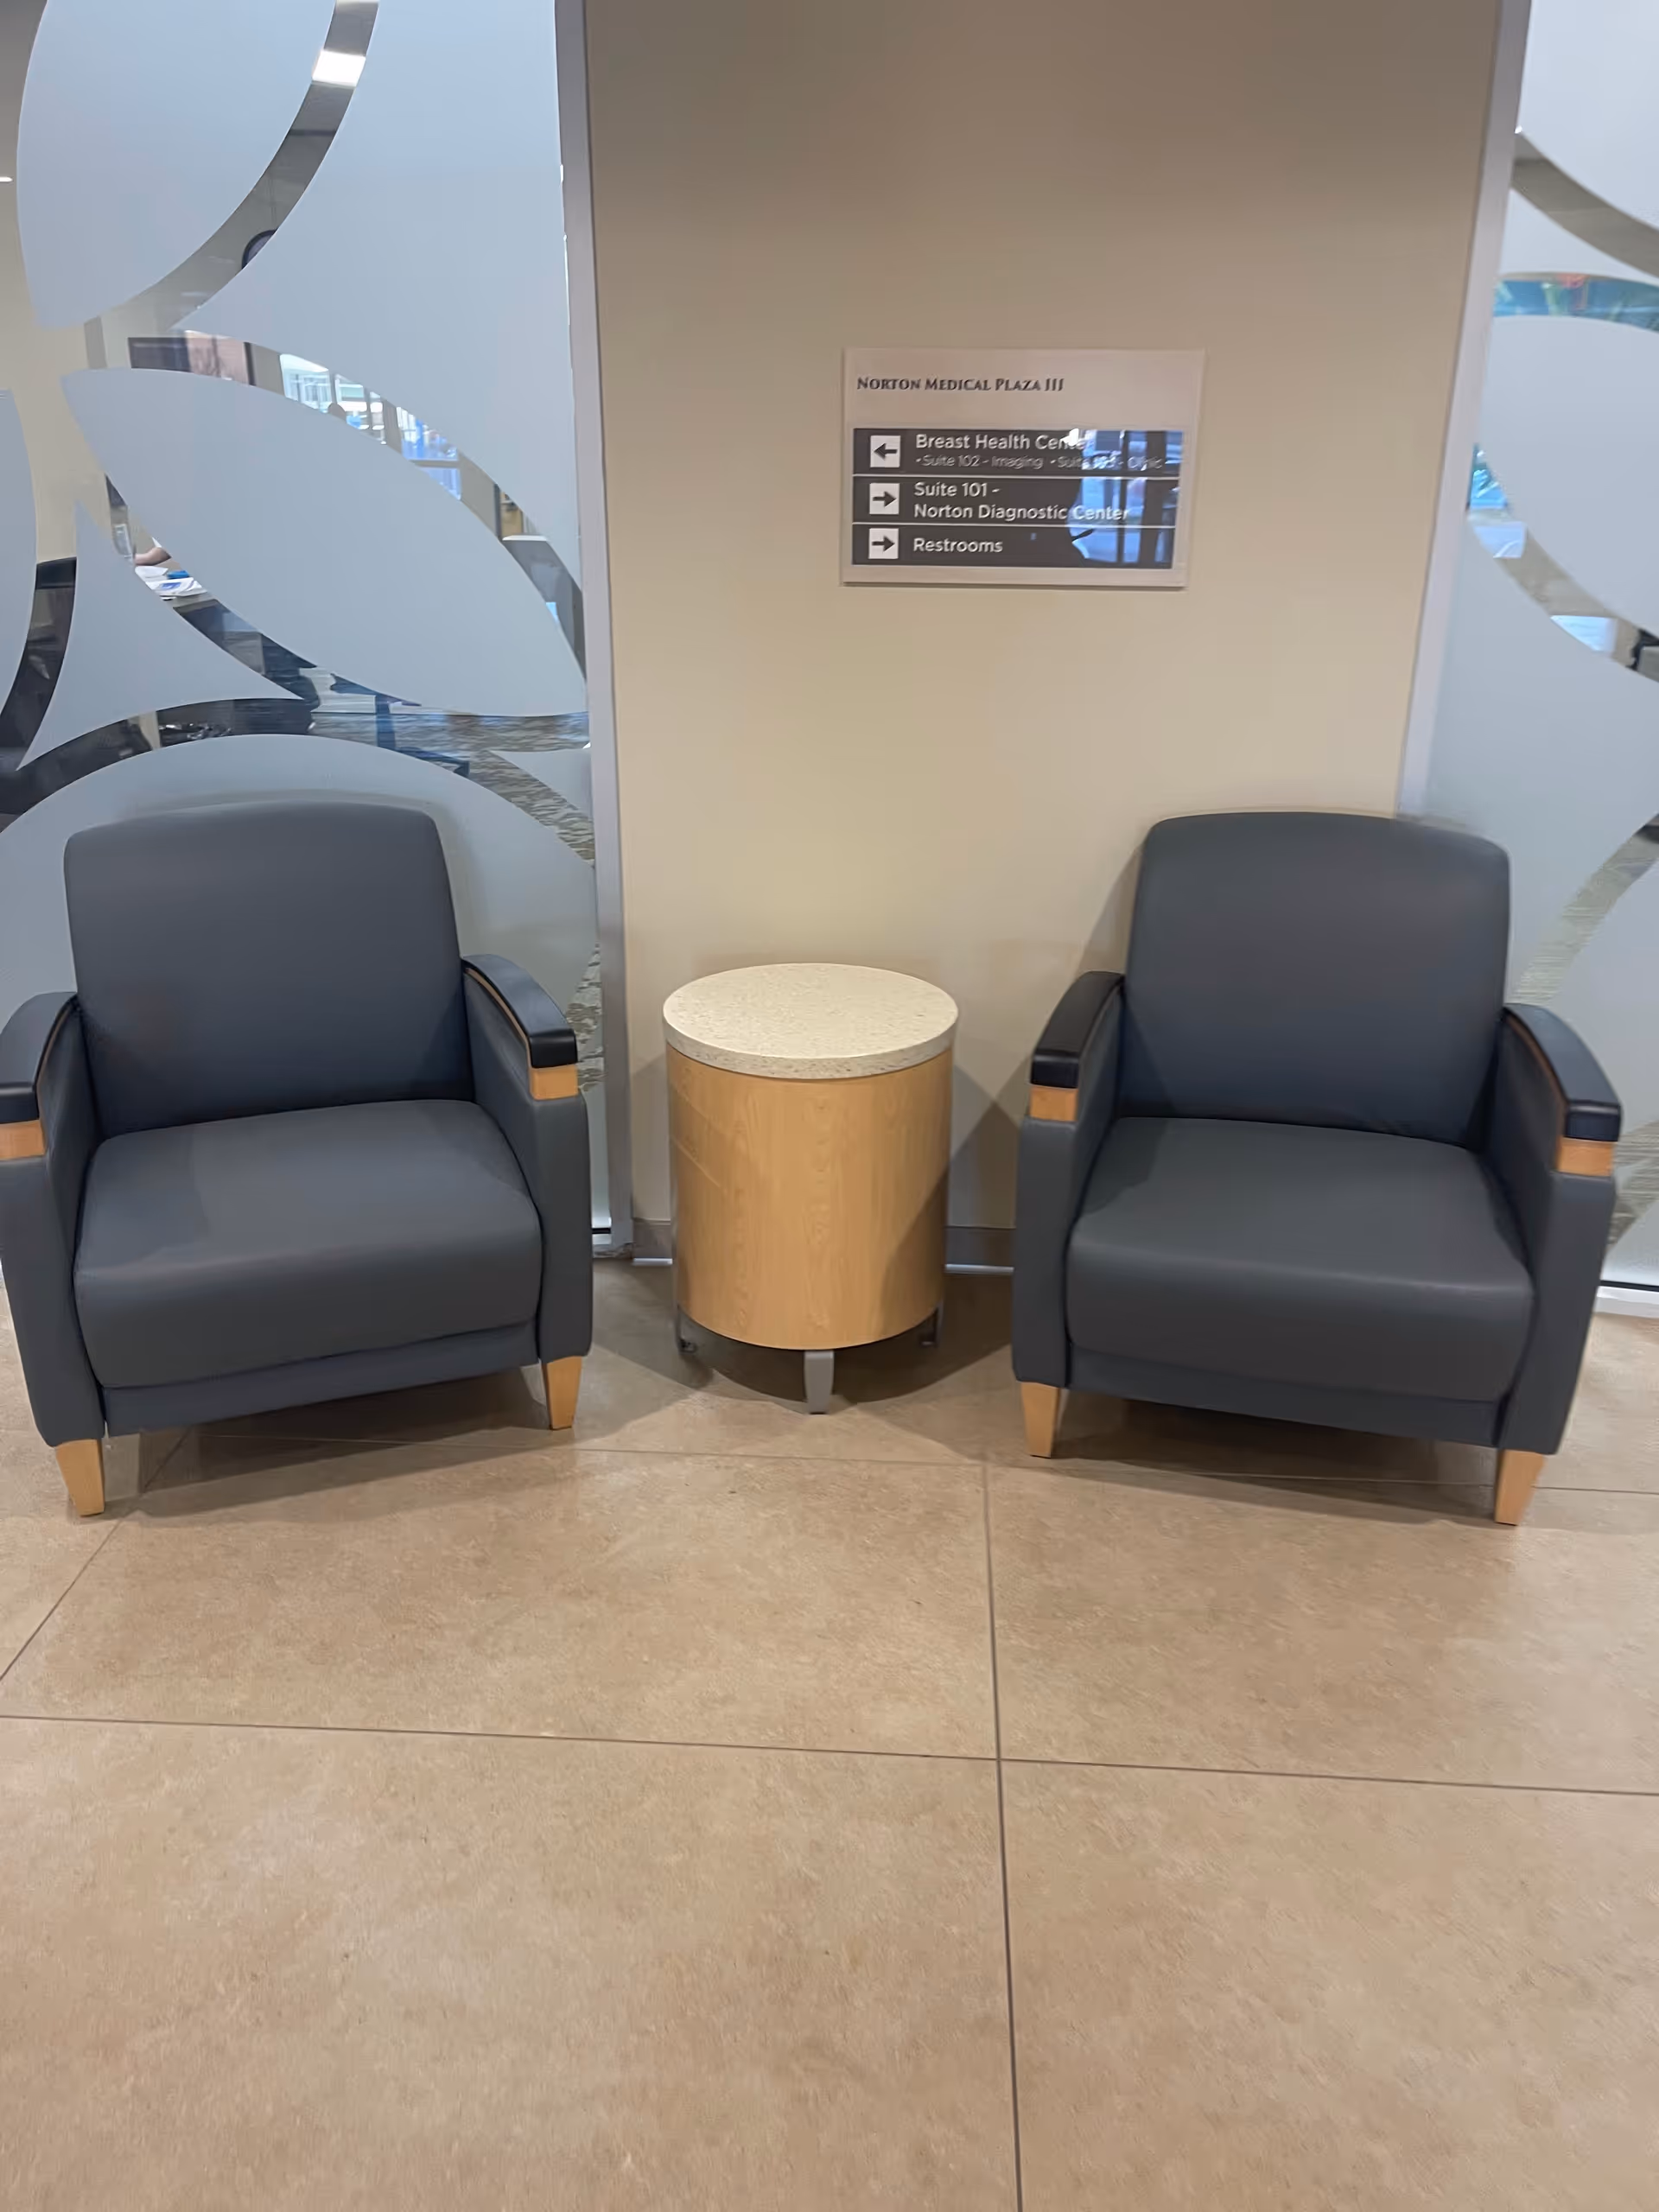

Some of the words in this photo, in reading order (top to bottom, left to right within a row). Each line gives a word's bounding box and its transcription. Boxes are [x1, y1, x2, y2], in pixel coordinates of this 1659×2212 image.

[1045, 378, 1065, 391] III
[915, 433, 970, 449] Breast
[975, 433, 1031, 450] Health
[1035, 435, 1095, 450] Cene
[921, 454, 956, 467] Suite
[958, 454, 981, 467] 102
[991, 454, 1044, 469] Imaging
[913, 481, 957, 497] Suite
[962, 482, 988, 498] 101
[913, 503, 973, 519] Norton
[978, 504, 1068, 522] Diagnostic
[1071, 505, 1131, 520] Center
[912, 537, 1004, 553] Restrooms
